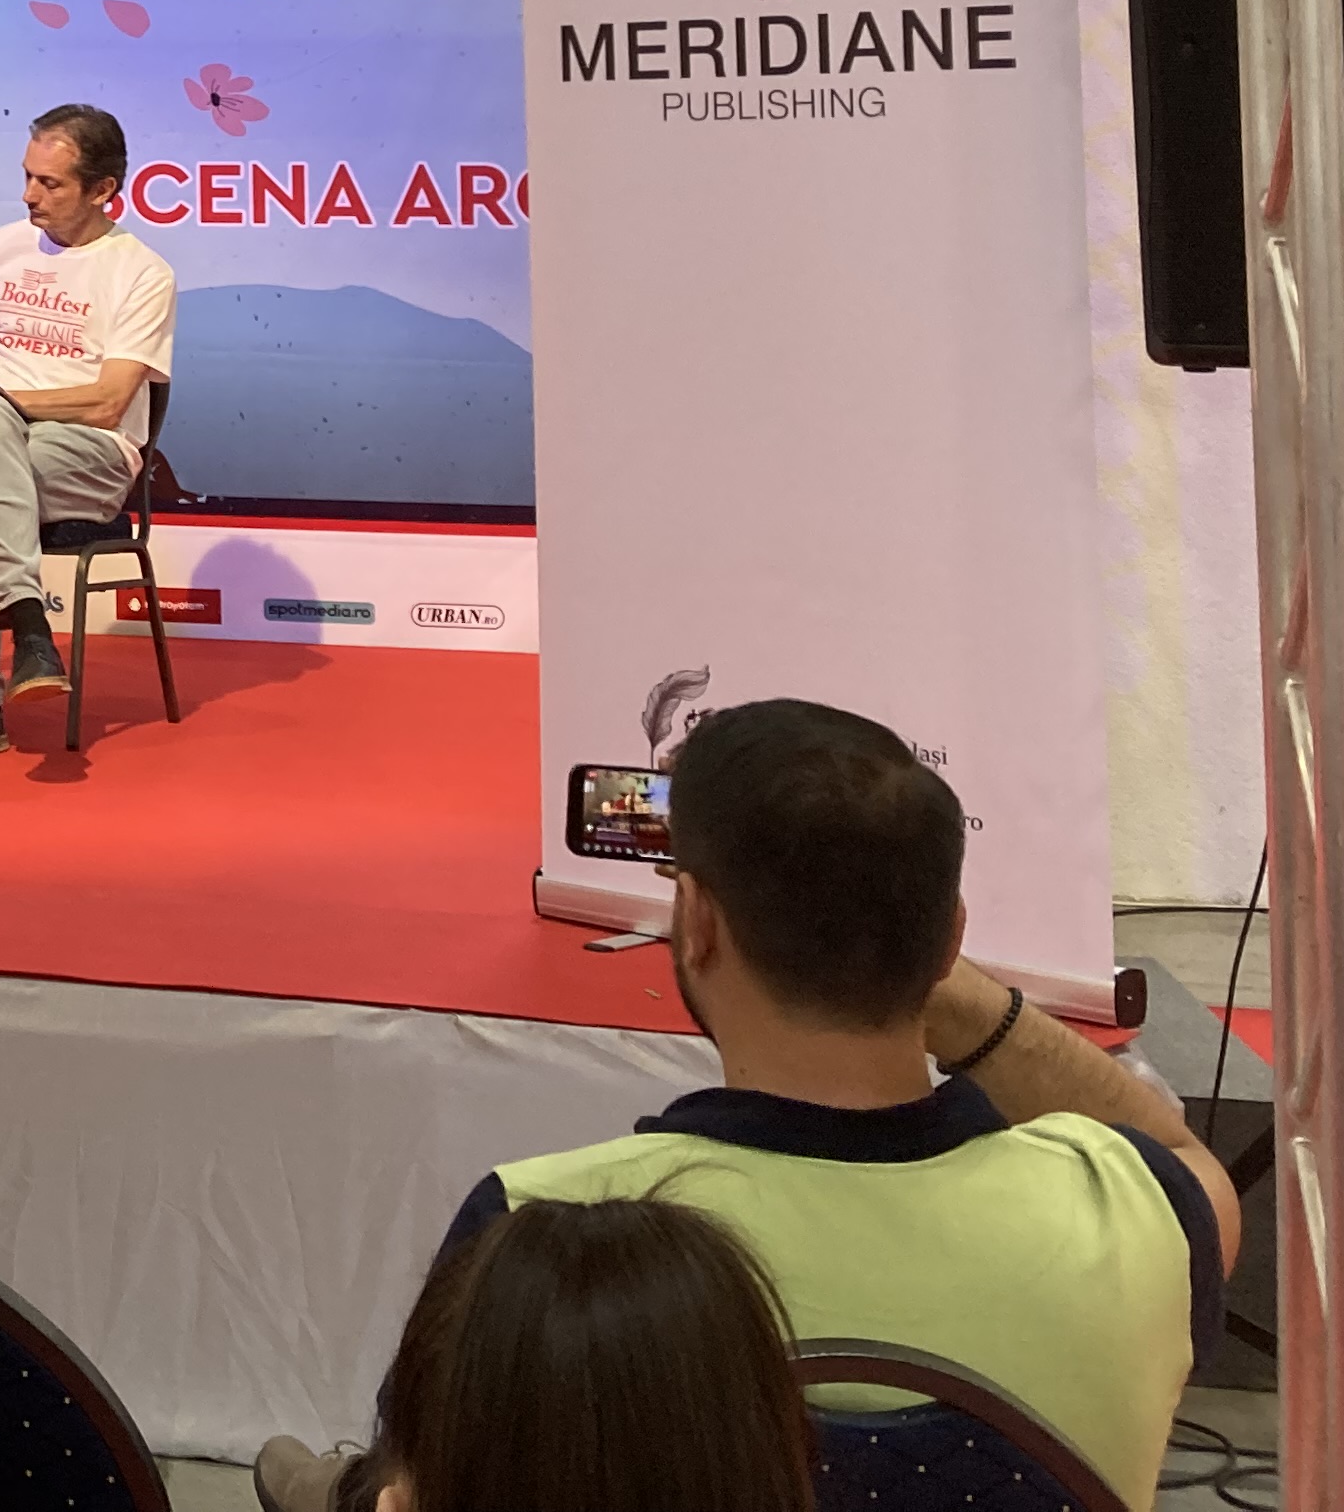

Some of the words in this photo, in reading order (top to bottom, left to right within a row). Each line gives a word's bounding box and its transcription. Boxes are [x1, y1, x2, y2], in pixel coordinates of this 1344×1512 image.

[560, 5, 1017, 82] MERIDIANE
[662, 87, 886, 121] PUBLISHING
[392, 164, 529, 226] AR
[0, 281, 93, 317] Bookfest
[32, 320, 83, 345] IUNIE
[268, 602, 372, 620] spotmedia.ro
